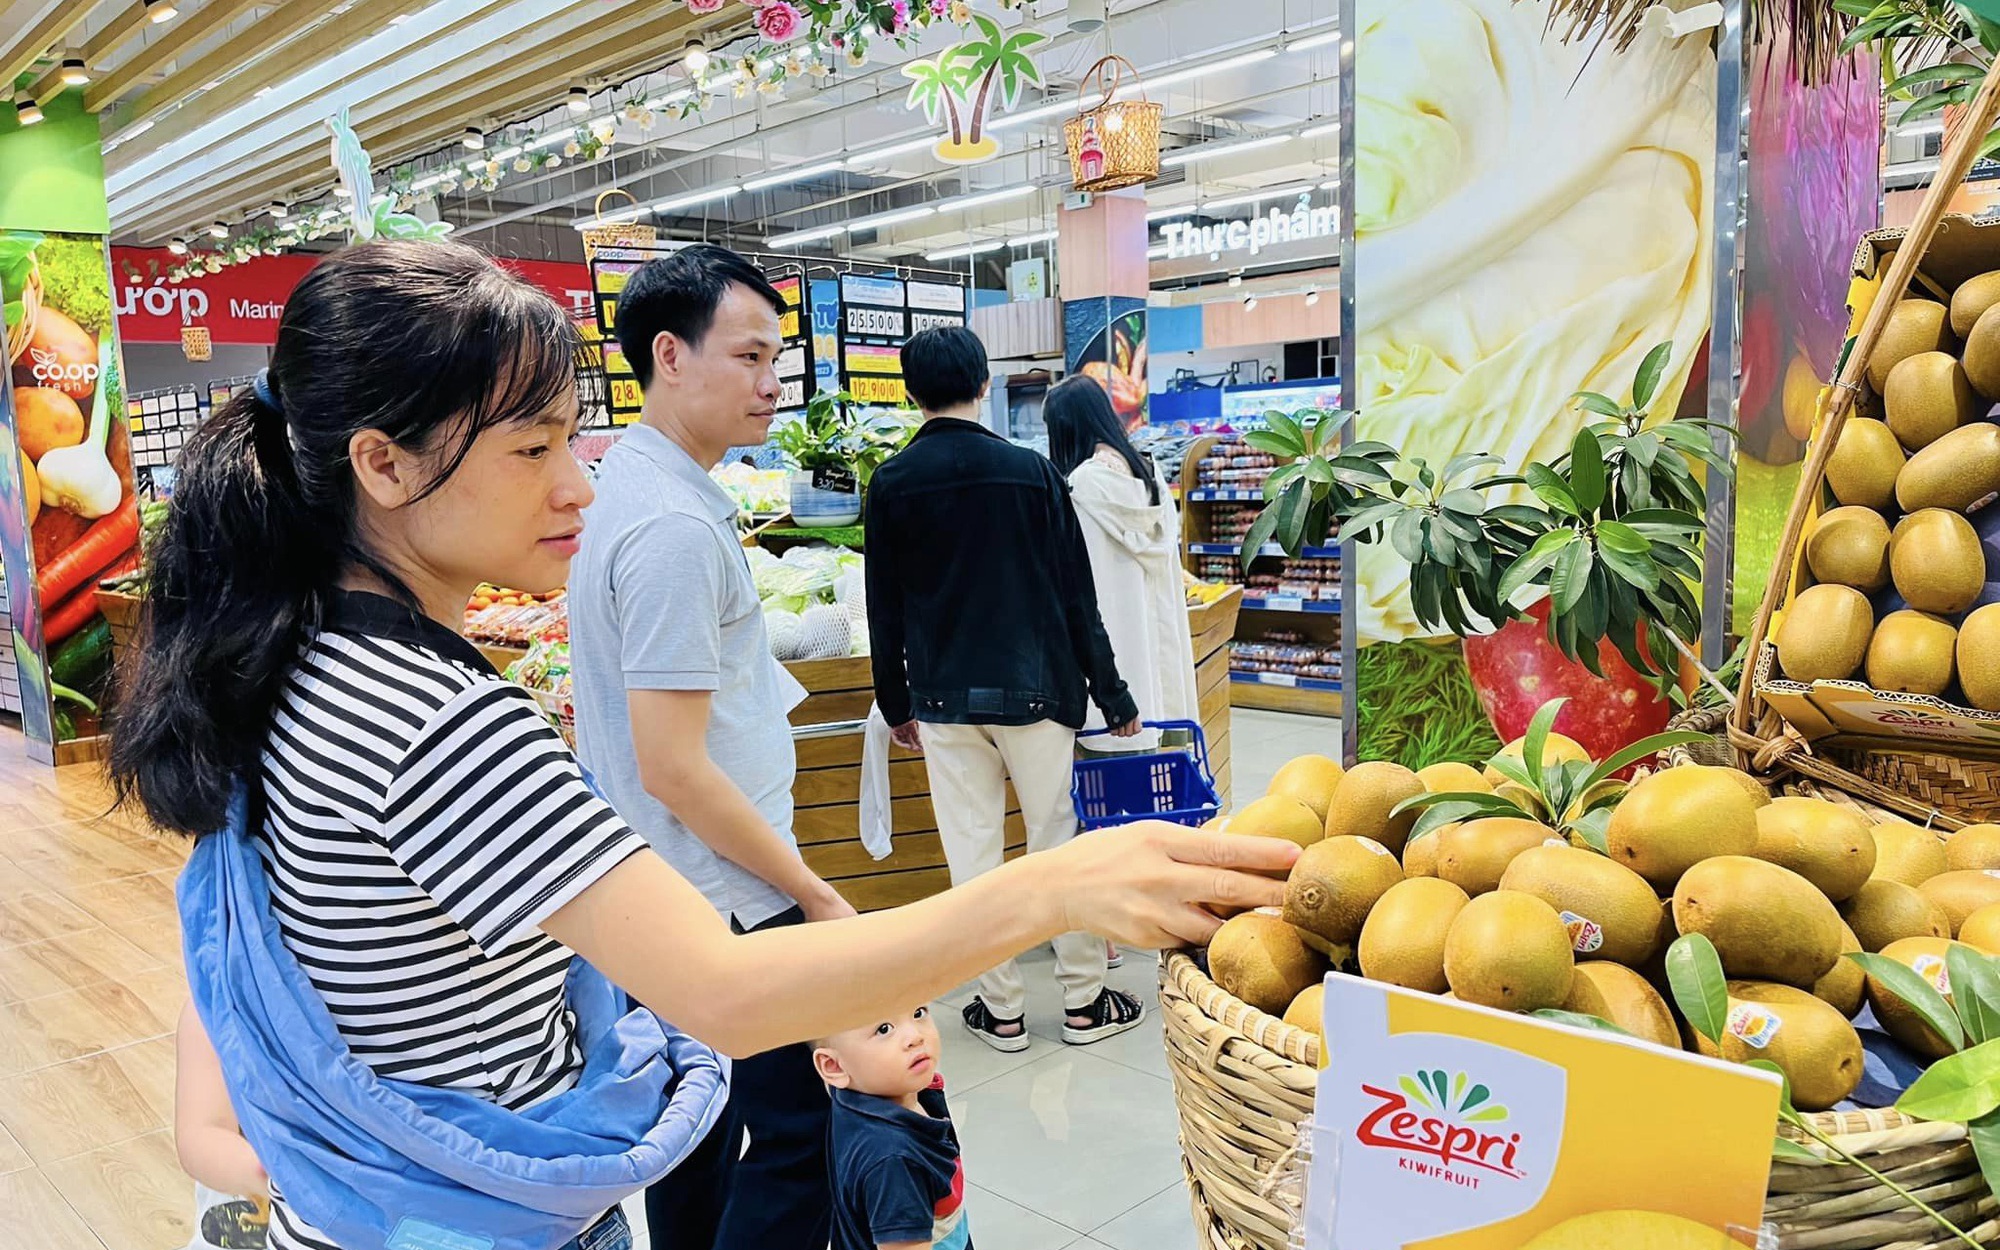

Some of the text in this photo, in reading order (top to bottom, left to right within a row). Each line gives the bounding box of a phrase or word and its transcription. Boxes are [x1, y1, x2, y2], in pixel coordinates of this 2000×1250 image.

[32, 363, 99, 385] co.op
[37, 380, 82, 392] fresh
[1356, 1083, 1522, 1180] Zespri
[1398, 1156, 1480, 1190] KIWIFRUIT
